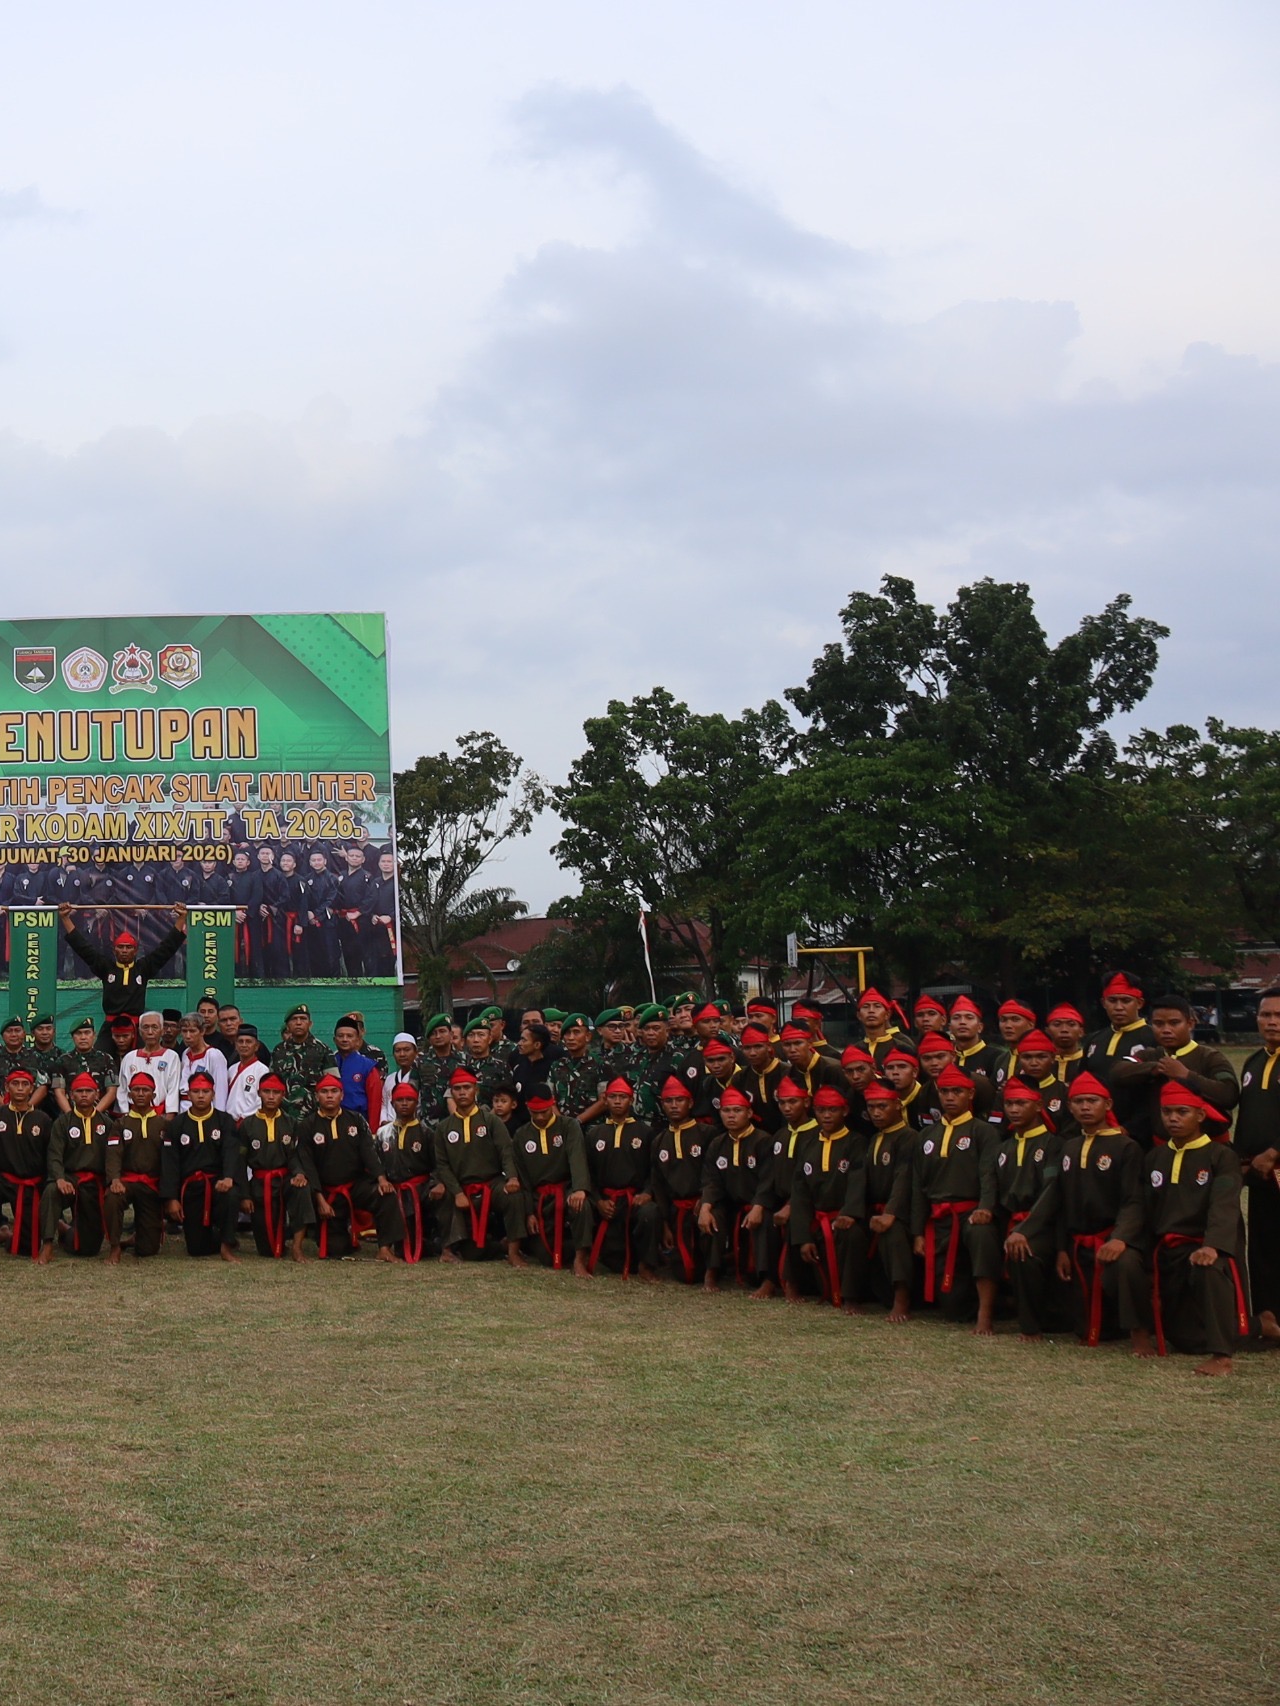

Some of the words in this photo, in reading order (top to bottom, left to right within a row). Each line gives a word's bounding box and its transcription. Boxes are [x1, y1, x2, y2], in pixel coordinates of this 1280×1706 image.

[47, 774, 164, 806] PENCAK
[171, 773, 252, 803] SILAT
[259, 772, 376, 802] MILITER
[26, 811, 128, 842] KODAM
[134, 810, 227, 840] XIX/TT
[242, 810, 280, 839] TA
[286, 808, 363, 839] 2026.
[67, 846, 90, 863] 30
[95, 844, 176, 864] JANUARI
[182, 843, 233, 864] 2026)
[13, 911, 54, 927] PSM
[191, 911, 232, 927] PSM
[26, 932, 40, 980] PENCAK
[204, 932, 218, 980] PENCAK
